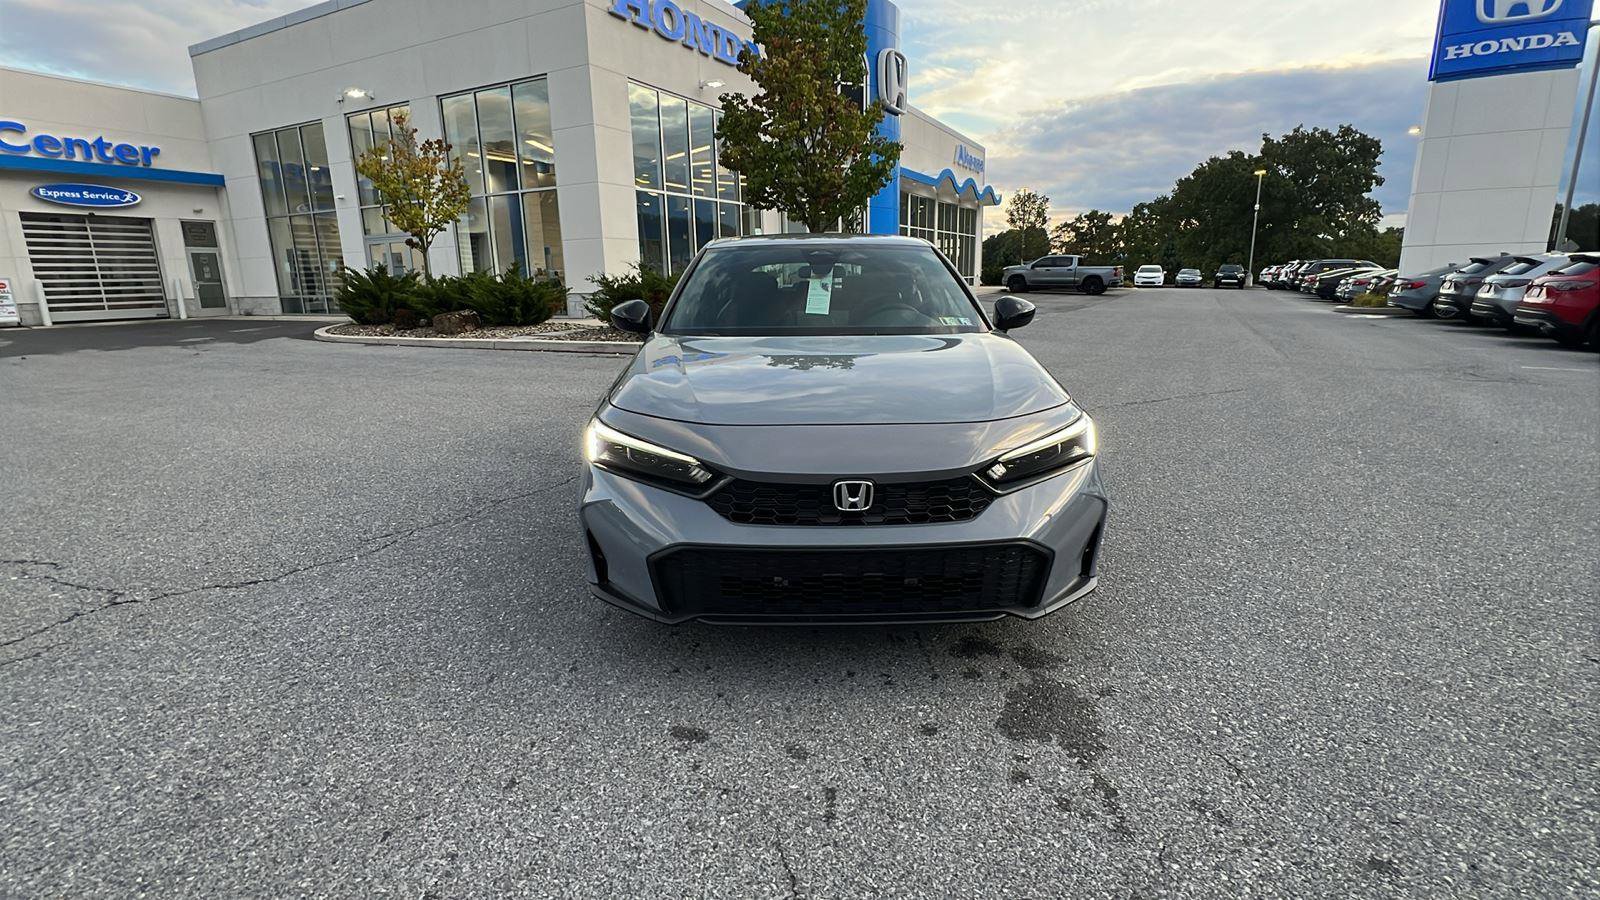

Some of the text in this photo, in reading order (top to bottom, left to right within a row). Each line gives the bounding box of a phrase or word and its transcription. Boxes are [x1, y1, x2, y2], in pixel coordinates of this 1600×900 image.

[608, 0, 760, 66] HOND
[1444, 31, 1581, 60] HONDA
[0, 121, 160, 167] Center
[39, 188, 120, 201] Express Service
